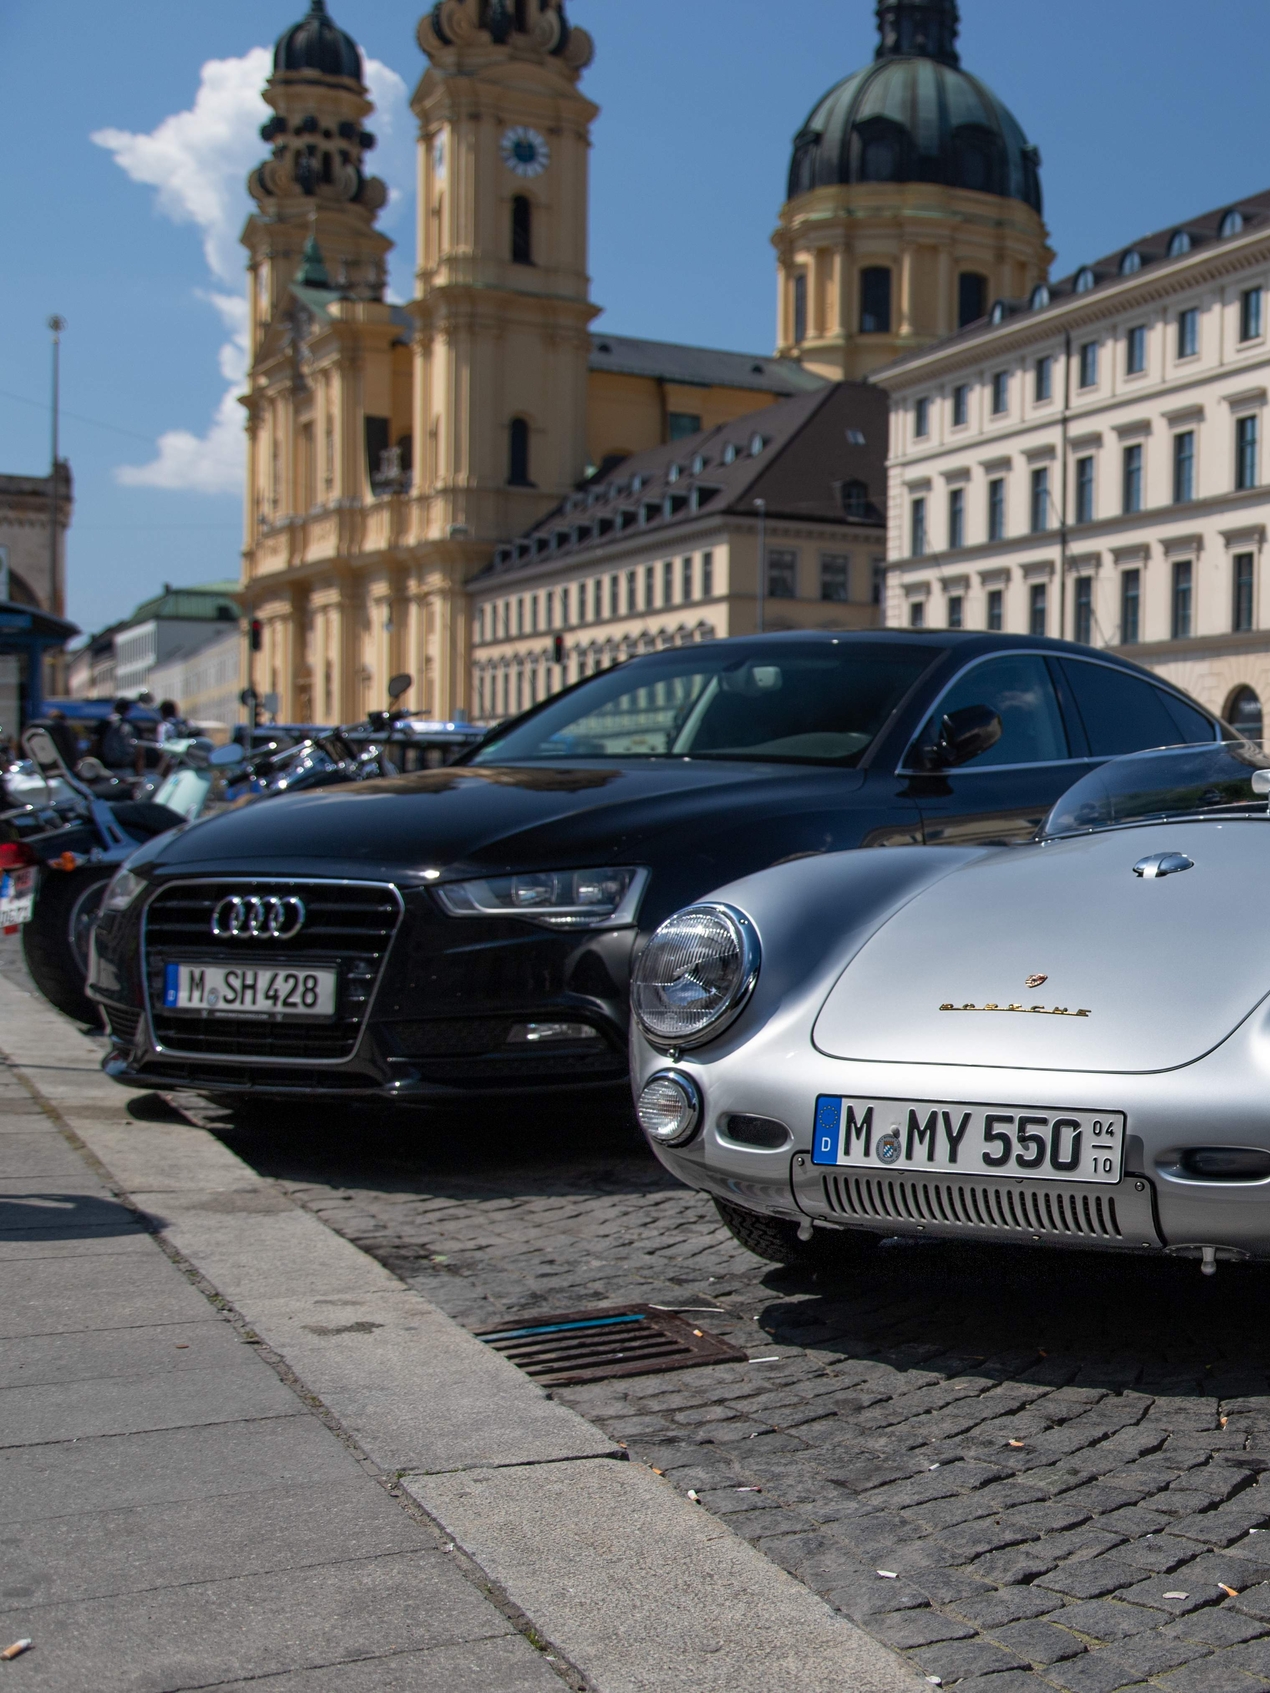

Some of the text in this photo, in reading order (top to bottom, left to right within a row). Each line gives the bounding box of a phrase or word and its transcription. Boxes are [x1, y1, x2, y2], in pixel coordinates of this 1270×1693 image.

[188, 969, 319, 1008] M SH 428
[843, 1103, 874, 1157] M
[905, 1107, 972, 1164] MY
[982, 1113, 1082, 1171] 550
[1092, 1119, 1115, 1137] 04
[821, 1137, 831, 1152] D
[1092, 1156, 1113, 1174] 10
